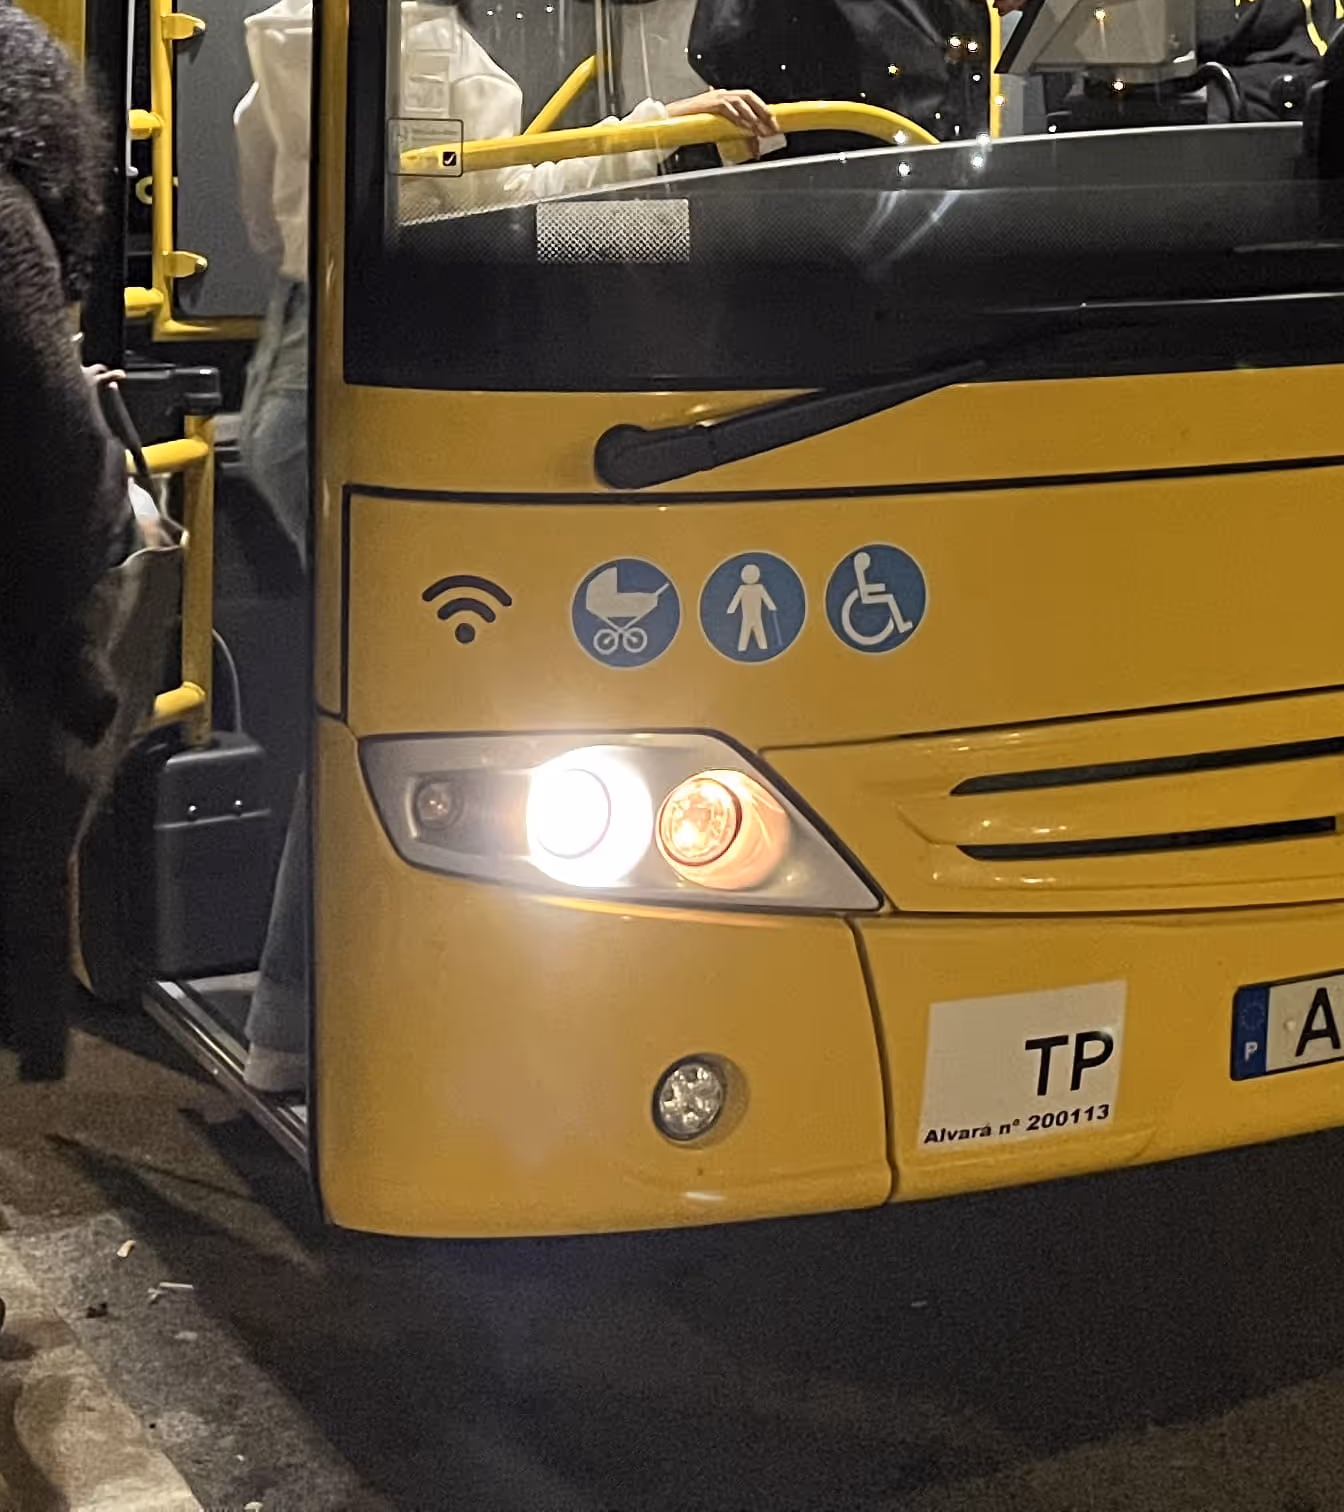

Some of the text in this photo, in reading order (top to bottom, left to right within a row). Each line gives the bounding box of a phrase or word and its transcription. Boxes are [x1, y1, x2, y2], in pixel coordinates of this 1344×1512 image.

[1024, 1030, 1114, 1097] TP
[1244, 1041, 1258, 1062] P
[923, 1123, 992, 1145] Alvará
[1027, 1103, 1110, 1131] 200113
